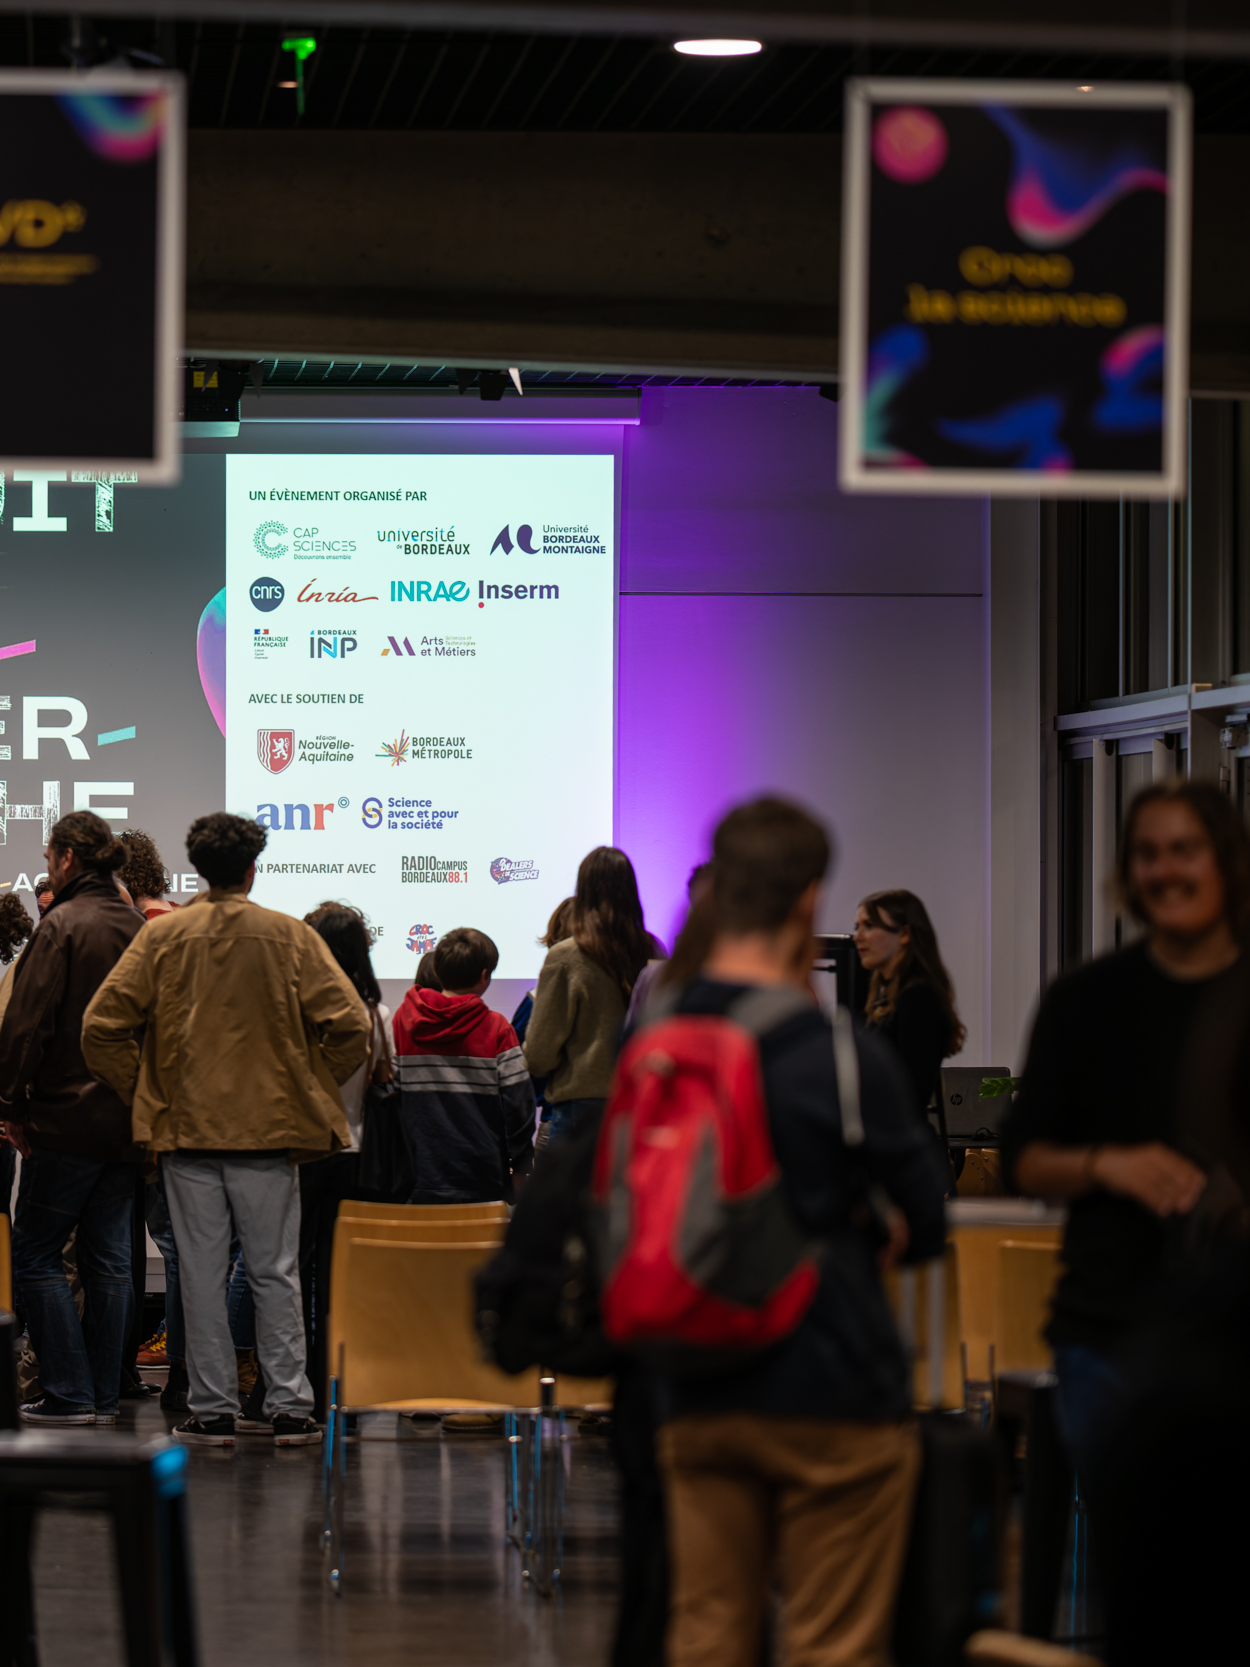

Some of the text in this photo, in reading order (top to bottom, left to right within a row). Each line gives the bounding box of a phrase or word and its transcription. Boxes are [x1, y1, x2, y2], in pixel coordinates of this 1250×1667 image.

[249, 488, 428, 501] UN ÉVÈNEMENT ORGANISÉ PAR
[293, 527, 319, 538] CAP
[377, 525, 455, 542] université
[542, 524, 589, 533] Université
[542, 535, 600, 544] BORDEAUX
[293, 541, 357, 551] SCIENCES
[404, 544, 470, 555] BORDEAUX
[542, 545, 607, 555] MONTAIGNE
[252, 585, 283, 599] cnrs
[478, 580, 560, 600] Inserm
[420, 636, 444, 646] Arts
[309, 636, 358, 659] INP
[420, 647, 476, 657] et Métiers
[248, 694, 364, 704] AVEC LE SOUTIEN DE
[298, 740, 354, 751] Nouvelle-
[411, 736, 466, 747] BORDEAUX
[298, 751, 354, 764] Aquitaine
[411, 746, 473, 759] MÉTROPOLE
[387, 797, 432, 808] Science
[256, 801, 335, 830] anr
[387, 810, 459, 821] avec et pour
[387, 819, 444, 830] la société
[266, 863, 344, 874] PARTENARIAT
[347, 863, 377, 874] AVEC
